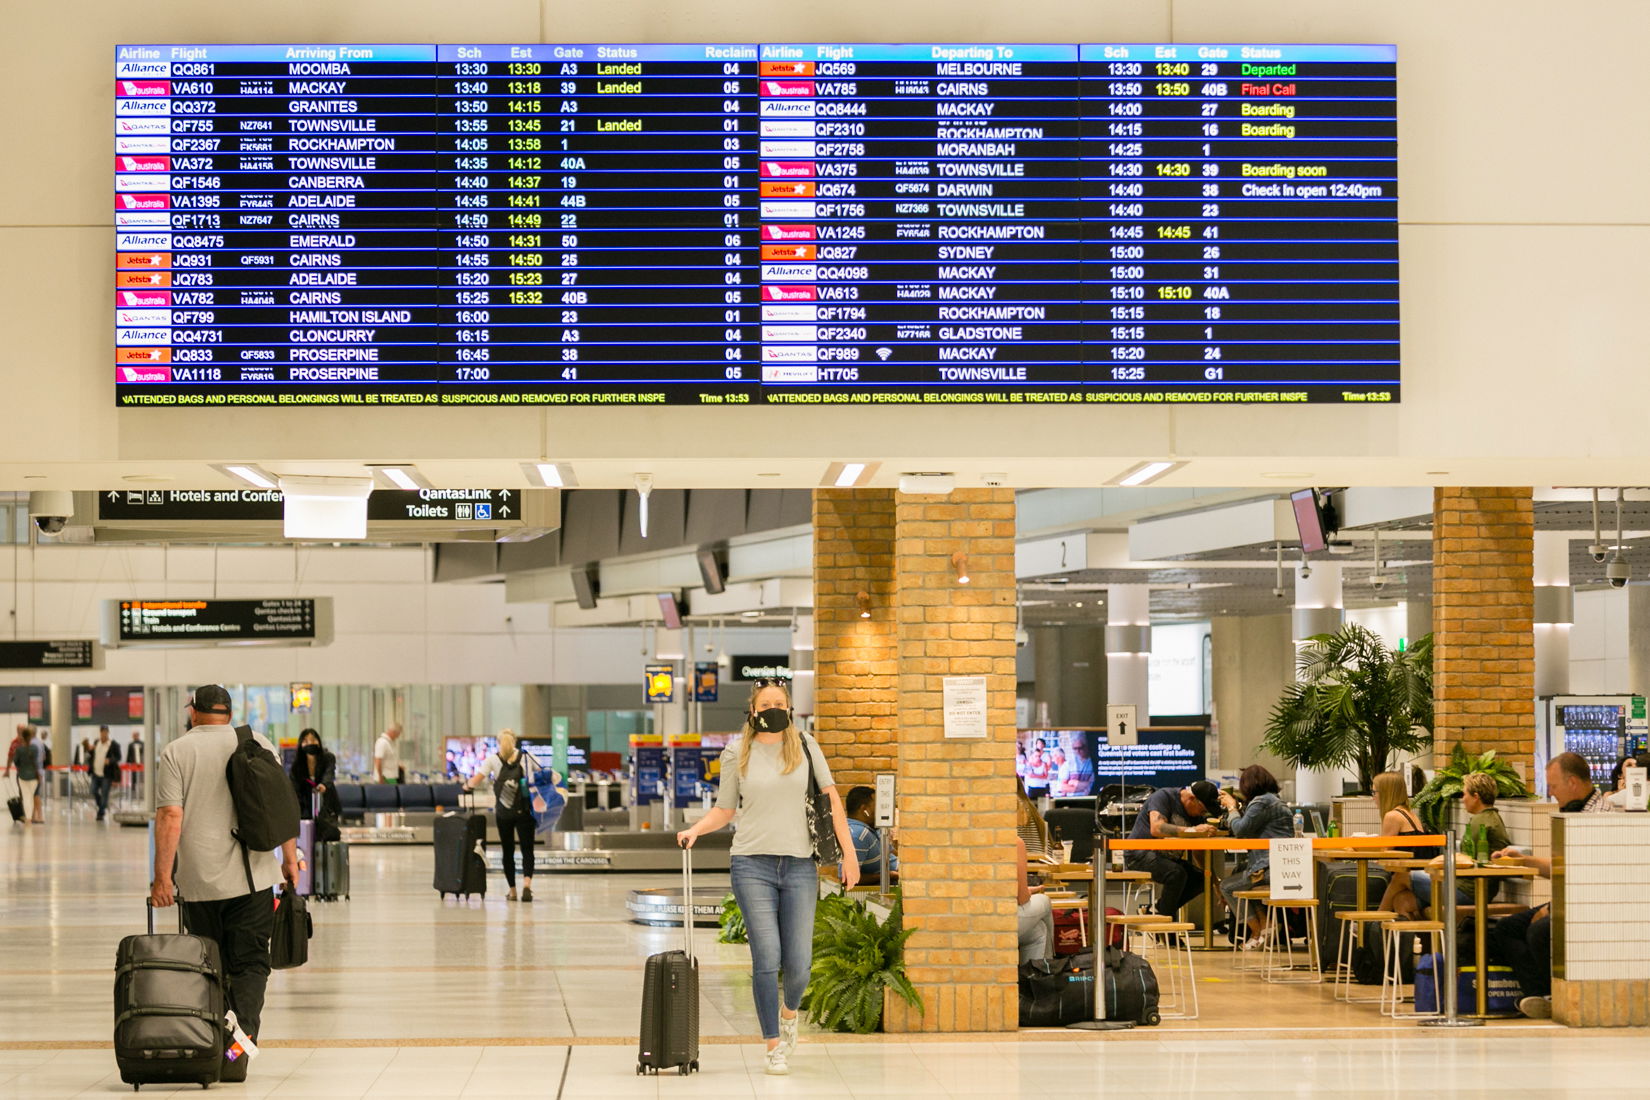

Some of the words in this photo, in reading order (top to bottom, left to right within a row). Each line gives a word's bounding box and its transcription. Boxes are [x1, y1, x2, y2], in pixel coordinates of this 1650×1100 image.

[120, 48, 160, 59] Airline
[172, 48, 206, 61] Flight
[286, 48, 340, 61] Arriving
[343, 48, 373, 59] From
[458, 47, 482, 58] Sch
[511, 48, 532, 58] Est
[554, 48, 584, 58] Gate
[597, 48, 638, 58] Status
[705, 47, 757, 58] Reclaim
[762, 47, 804, 58] Airline
[817, 47, 854, 60] Flight
[932, 47, 994, 60] Departing
[996, 47, 1014, 58] To
[1104, 47, 1129, 58] Sch
[1155, 47, 1176, 58] Est
[1198, 47, 1228, 58] Gate
[1241, 47, 1282, 58] Status
[121, 63, 167, 73] Alliance
[172, 63, 214, 75] QQ861
[289, 63, 350, 75] MOOMBA
[455, 63, 487, 75] 13:30
[508, 63, 541, 75] 13:30
[561, 63, 577, 75] A3
[598, 63, 641, 75] Landed
[724, 63, 739, 75] 04
[815, 64, 855, 75] JQ569
[937, 64, 1022, 75] MELBOURNE
[1108, 64, 1142, 75] 13:30
[1156, 64, 1189, 75] 13:40
[1202, 64, 1218, 75] 29
[1242, 64, 1296, 78] Departed
[172, 82, 213, 94] VA610
[289, 82, 345, 94] MACKAY
[455, 82, 488, 94] 13:40
[508, 82, 541, 94] 13:18
[561, 82, 576, 94] 39
[598, 82, 641, 94] Landed
[724, 82, 739, 94] 05
[815, 84, 856, 95] VA785
[937, 84, 988, 95] CAIRNS
[1109, 84, 1142, 95] 13:50
[1156, 84, 1189, 95] 13:50
[1202, 84, 1227, 95] 40B
[1241, 84, 1270, 96] Final
[1273, 84, 1296, 96] Call
[172, 101, 215, 113] QQ372
[289, 101, 357, 113] GRANITES
[455, 101, 487, 113] 13:50
[508, 101, 541, 113] 14:15
[561, 101, 577, 113] A3
[724, 101, 739, 113] 04
[815, 104, 866, 115] QQ8444
[937, 104, 994, 115] MACKAY
[1109, 104, 1142, 115] 14:00
[1202, 104, 1218, 115] 27
[1242, 104, 1295, 118] Boarding
[172, 120, 213, 131] QF755
[240, 121, 272, 130] NZ7641
[289, 120, 375, 131] TOWNSVILLE
[455, 120, 487, 131] 13:55
[508, 120, 541, 131] 13:45
[561, 120, 574, 131] 21
[598, 120, 641, 131] Landed
[724, 120, 738, 131] 01
[815, 164, 857, 176] VA375
[937, 164, 1024, 176] TOWNSVILLE
[1109, 164, 1142, 176] 14:30
[1157, 164, 1190, 176] 14:30
[1203, 164, 1218, 176] 39
[1242, 164, 1295, 178] Boarding
[1298, 166, 1327, 176] soon
[815, 184, 856, 196] JQ674
[938, 184, 992, 196] DARWIN
[1109, 184, 1143, 196] 14:40
[1203, 184, 1219, 196] 38
[1242, 184, 1282, 196] Check
[1296, 186, 1327, 198] open
[1330, 184, 1382, 198] 12:40pm
[172, 255, 211, 266] JQ931
[241, 256, 274, 266] QF5931
[290, 255, 341, 266] CAIRNS
[456, 255, 489, 266] 14:55
[509, 255, 542, 266] 14:50
[562, 255, 577, 266] 25
[725, 255, 741, 266] 04
[172, 311, 214, 323] QF799
[290, 311, 359, 323] HAMILTON
[362, 311, 411, 323] ISLAND
[456, 311, 489, 323] 16:00
[562, 311, 577, 323] 23
[726, 311, 739, 323] 01
[700, 394, 722, 403] Time
[725, 394, 749, 403] 13:53
[1342, 392, 1366, 402] Time
[1366, 392, 1391, 402] 13:53
[170, 490, 210, 502] Hotels
[214, 490, 238, 502] and
[420, 488, 492, 501] QantasLink
[406, 505, 448, 517] Toilets
[152, 624, 172, 632] Hotels
[172, 624, 185, 632] and
[185, 624, 220, 632] Conference
[1278, 844, 1304, 852] ENTRY
[694, 906, 714, 914] THEM
